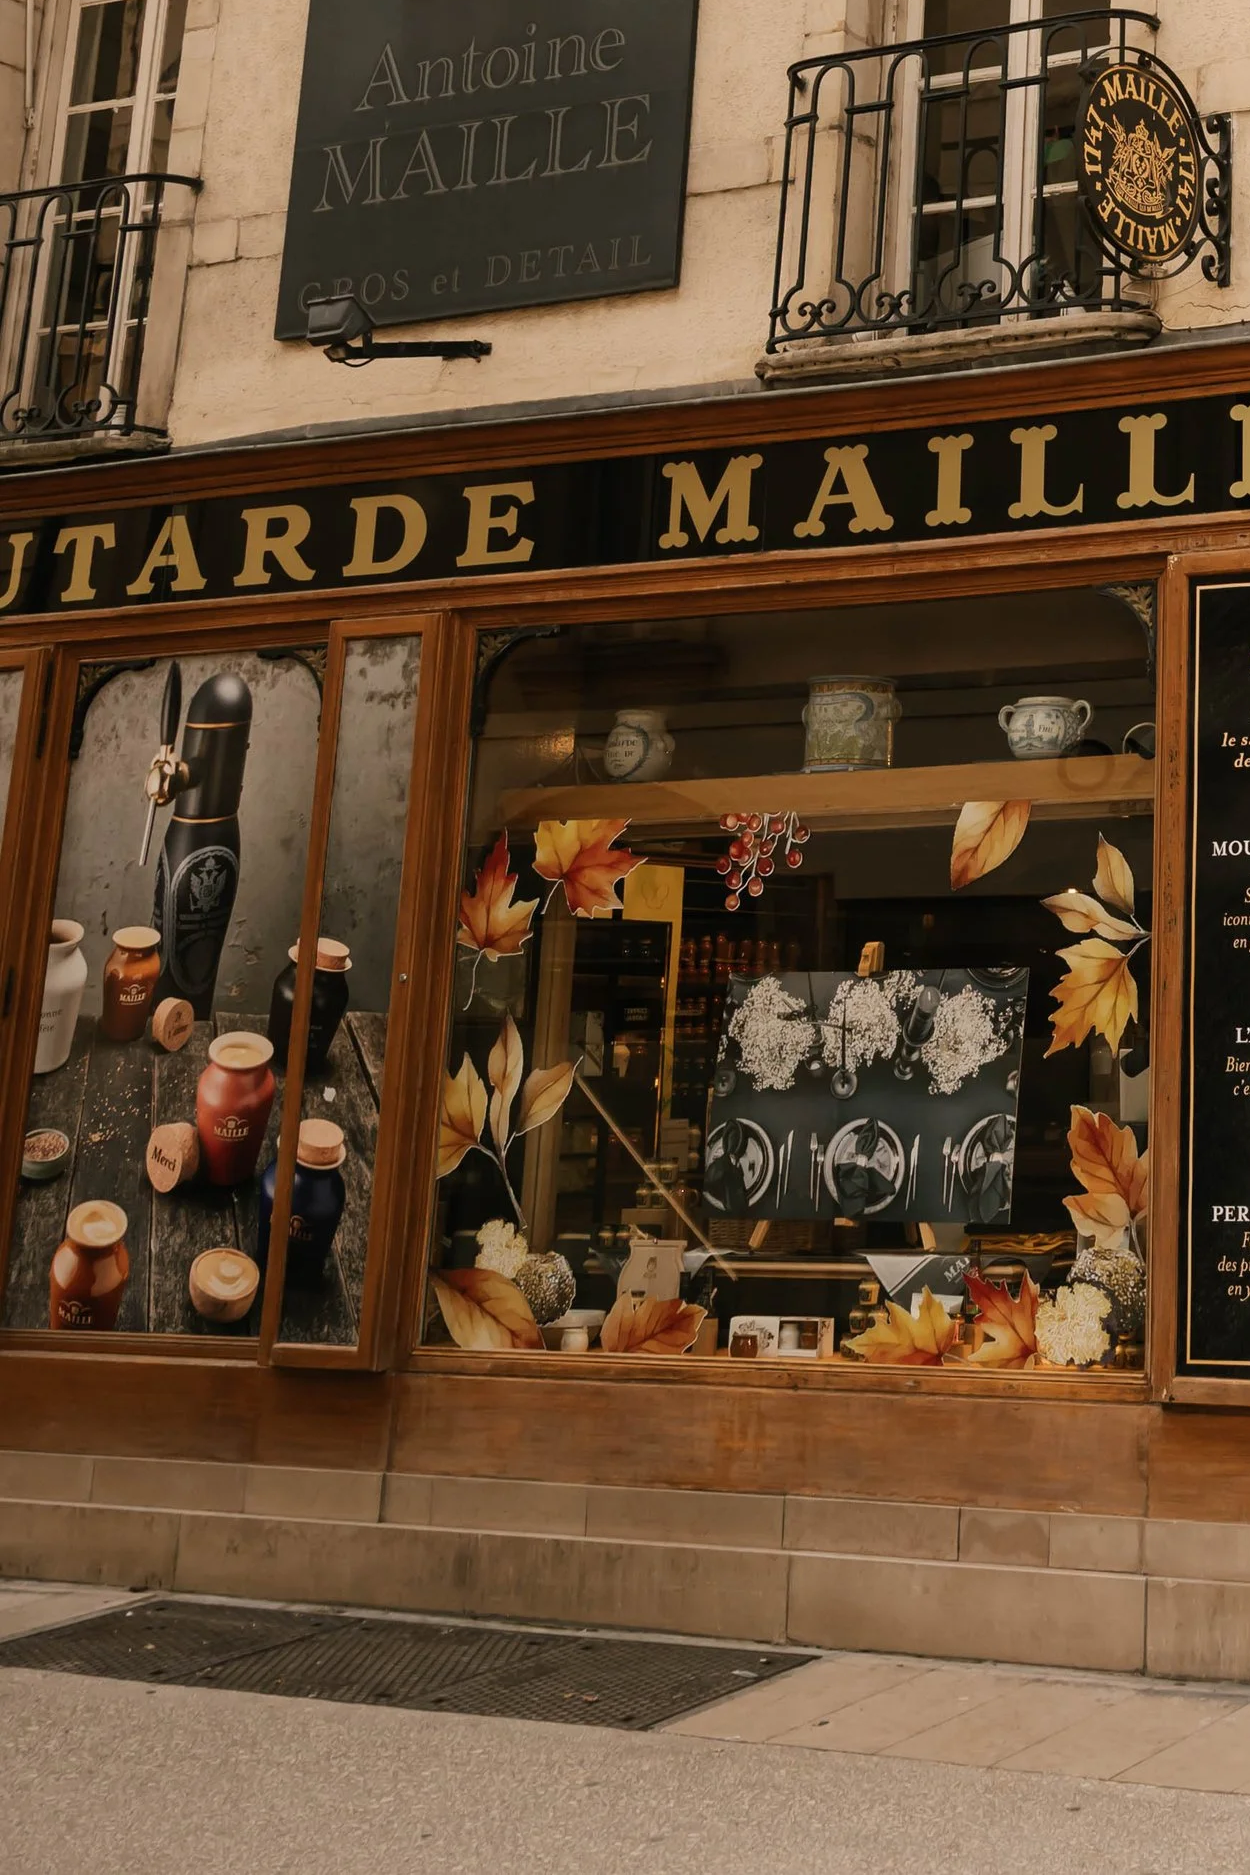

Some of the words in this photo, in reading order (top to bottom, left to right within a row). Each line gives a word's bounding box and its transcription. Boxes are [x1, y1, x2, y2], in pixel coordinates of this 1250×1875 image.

[355, 22, 626, 113] Antoine
[1103, 74, 1184, 137] MAILLE
[312, 93, 653, 214] MAILLE
[1097, 192, 1179, 254] MAILLE
[430, 255, 465, 295] et
[485, 234, 652, 288] DETAIL
[1221, 732, 1236, 747] le
[1233, 938, 1247, 948] en
[213, 1126, 249, 1138] MAILLE
[151, 1146, 177, 1172] Merci
[1217, 1256, 1237, 1272] des
[1227, 1287, 1241, 1296] en
